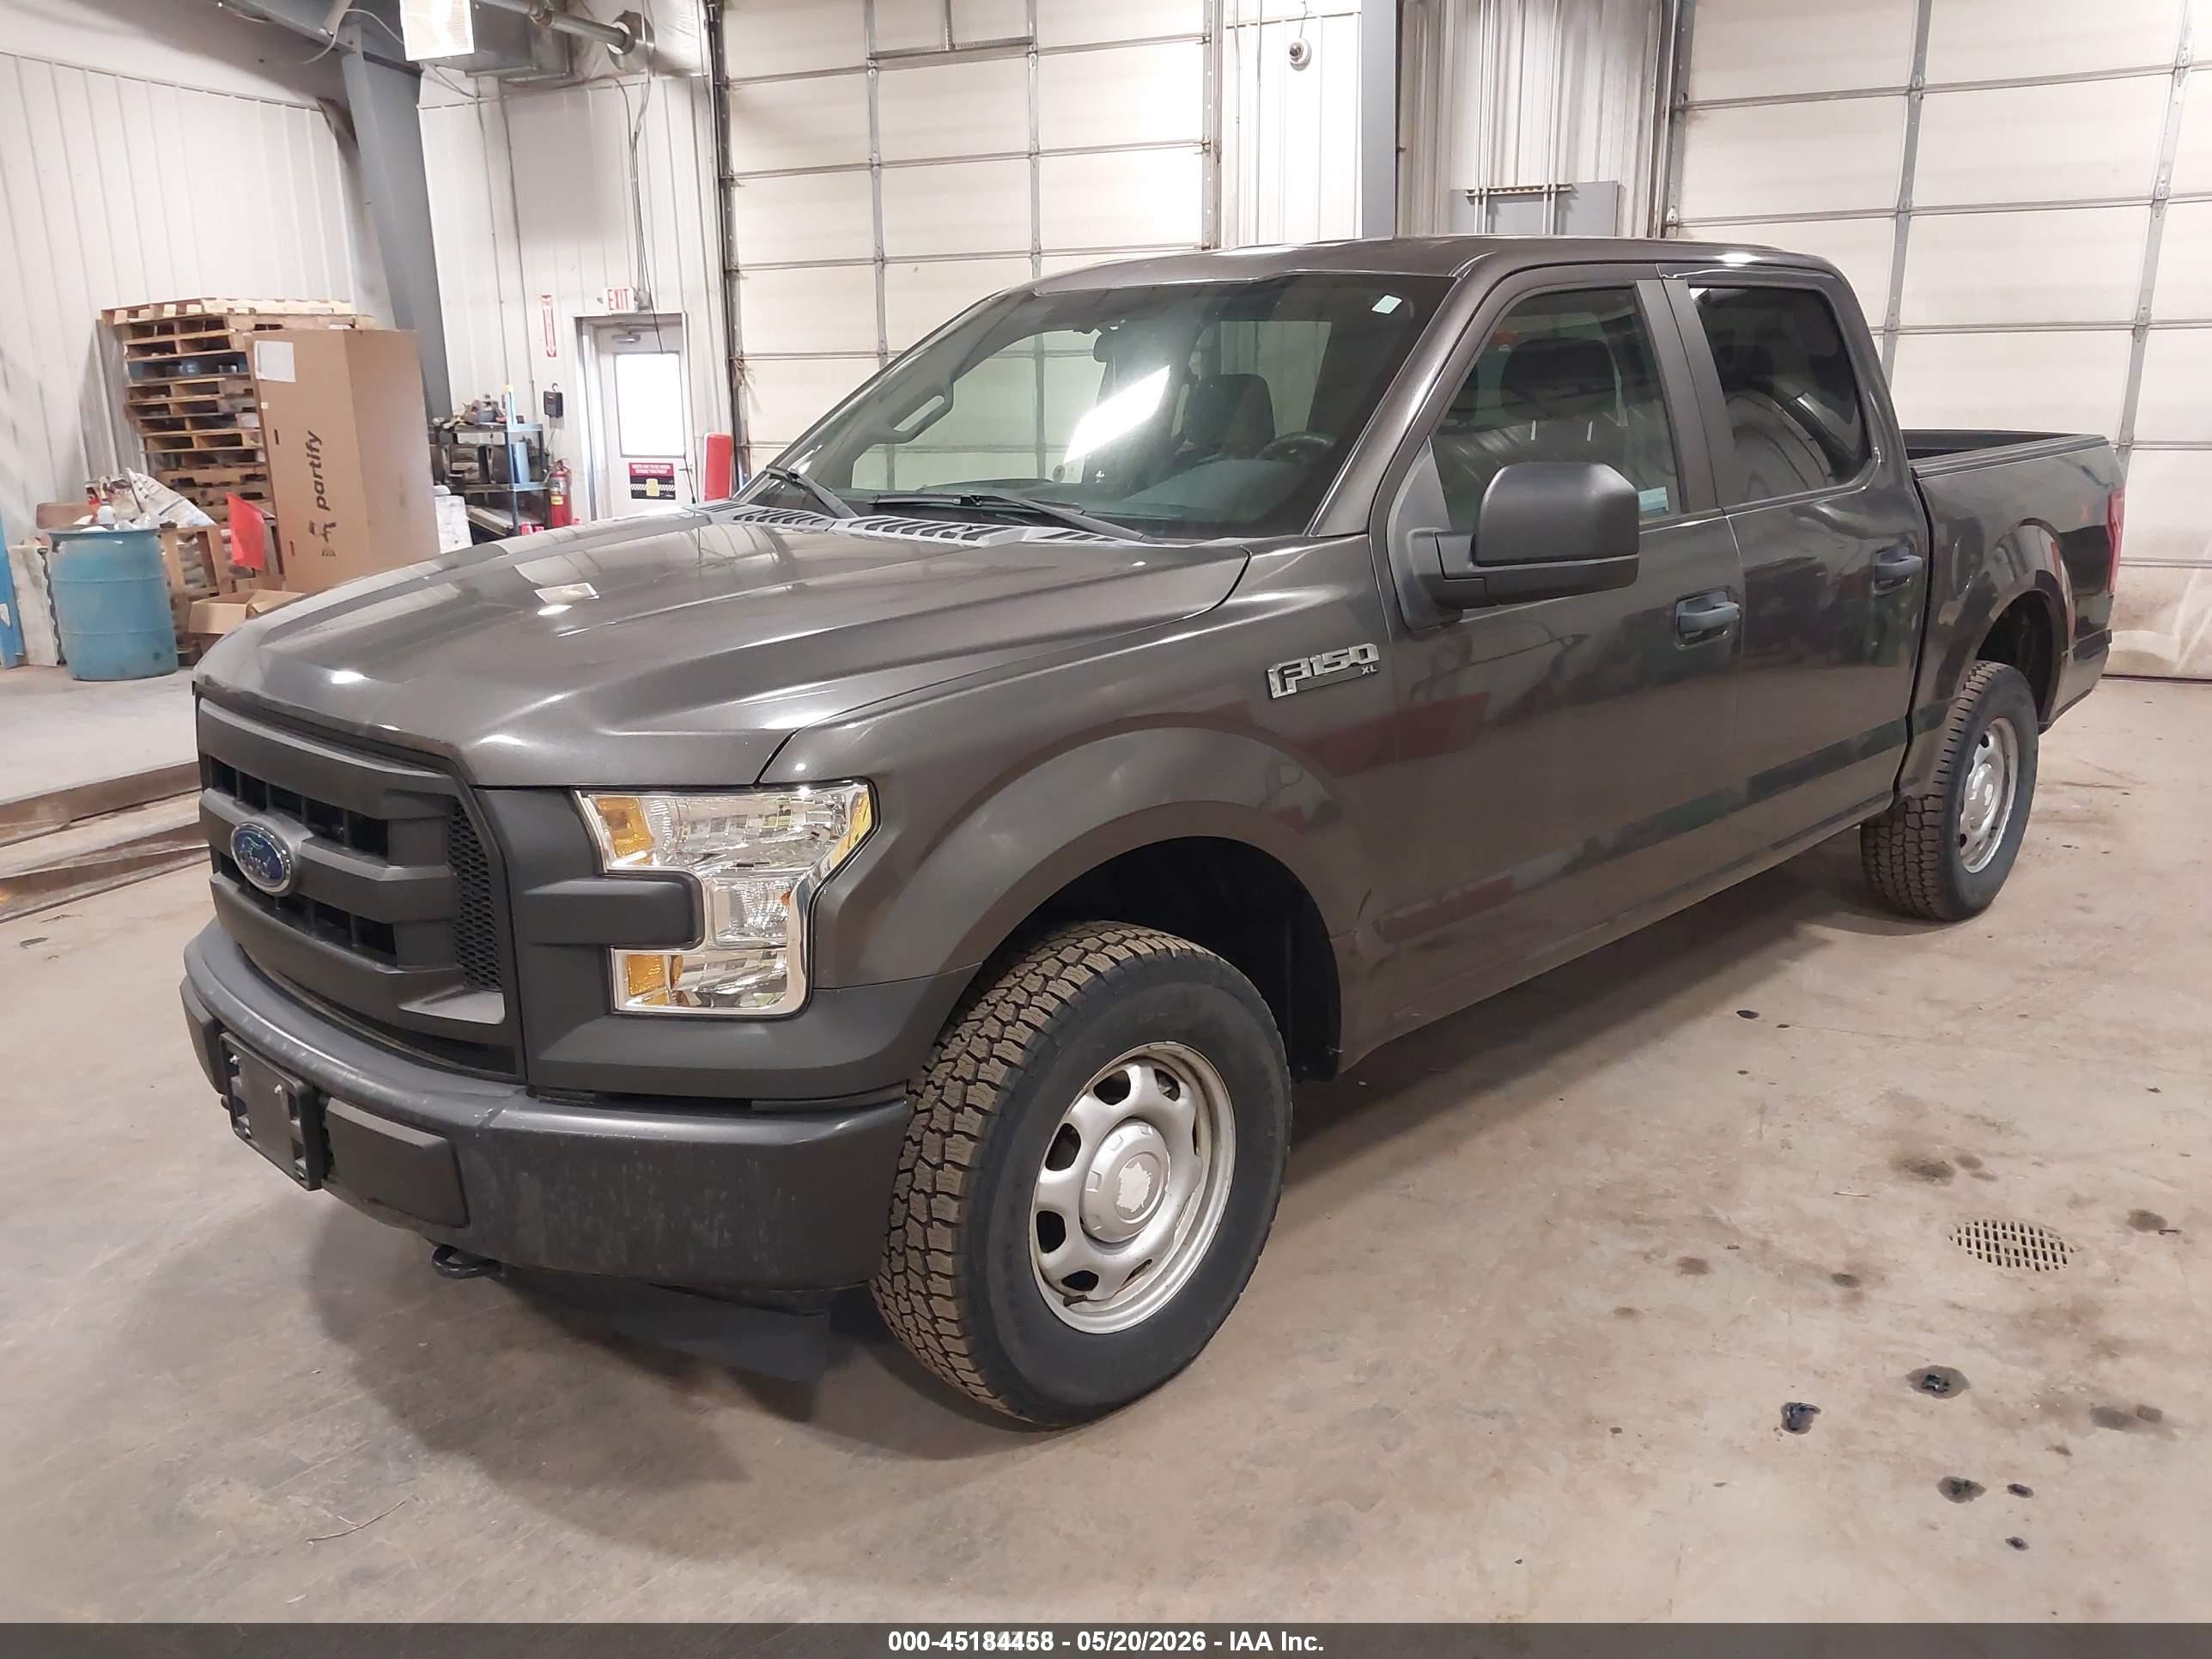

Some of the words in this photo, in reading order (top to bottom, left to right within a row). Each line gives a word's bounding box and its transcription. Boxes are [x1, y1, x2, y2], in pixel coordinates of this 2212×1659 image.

[607, 289, 629, 310] EXIT
[305, 429, 331, 512] partify
[1361, 665, 1378, 675] XL
[240, 836, 272, 878] Ford
